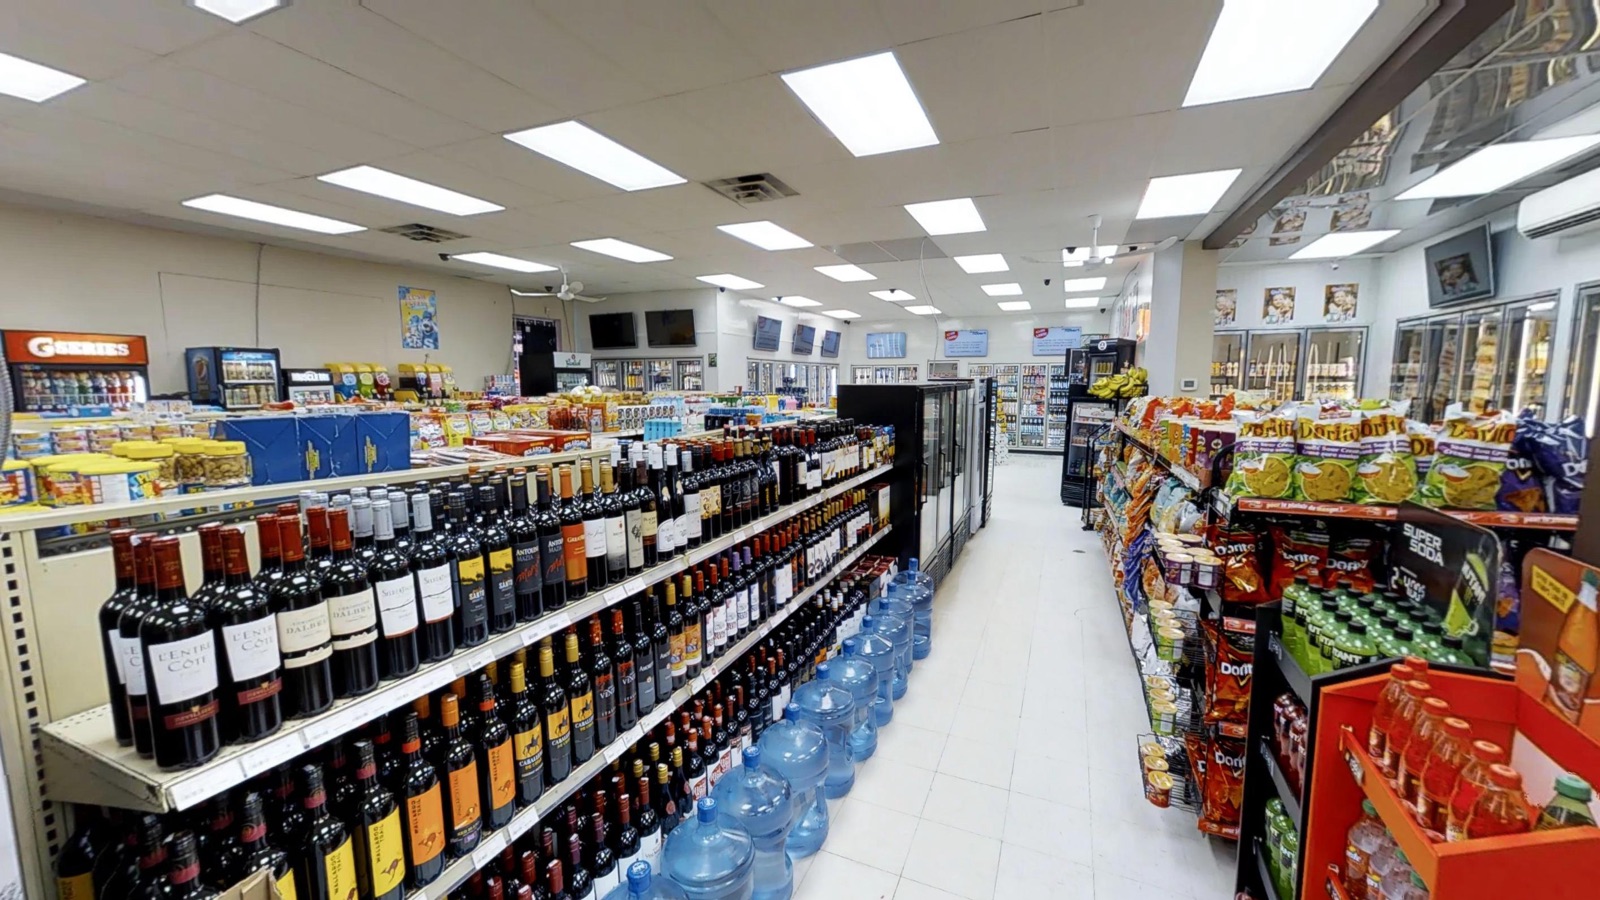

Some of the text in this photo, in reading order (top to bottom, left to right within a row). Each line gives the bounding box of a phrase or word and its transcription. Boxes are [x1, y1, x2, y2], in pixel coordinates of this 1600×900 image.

[1403, 523, 1443, 551] SUPER
[1409, 540, 1445, 567] SODA
[411, 800, 419, 834] WALLAROO
[373, 826, 381, 863] WALLAROO
[330, 855, 339, 895] WALLAROO
